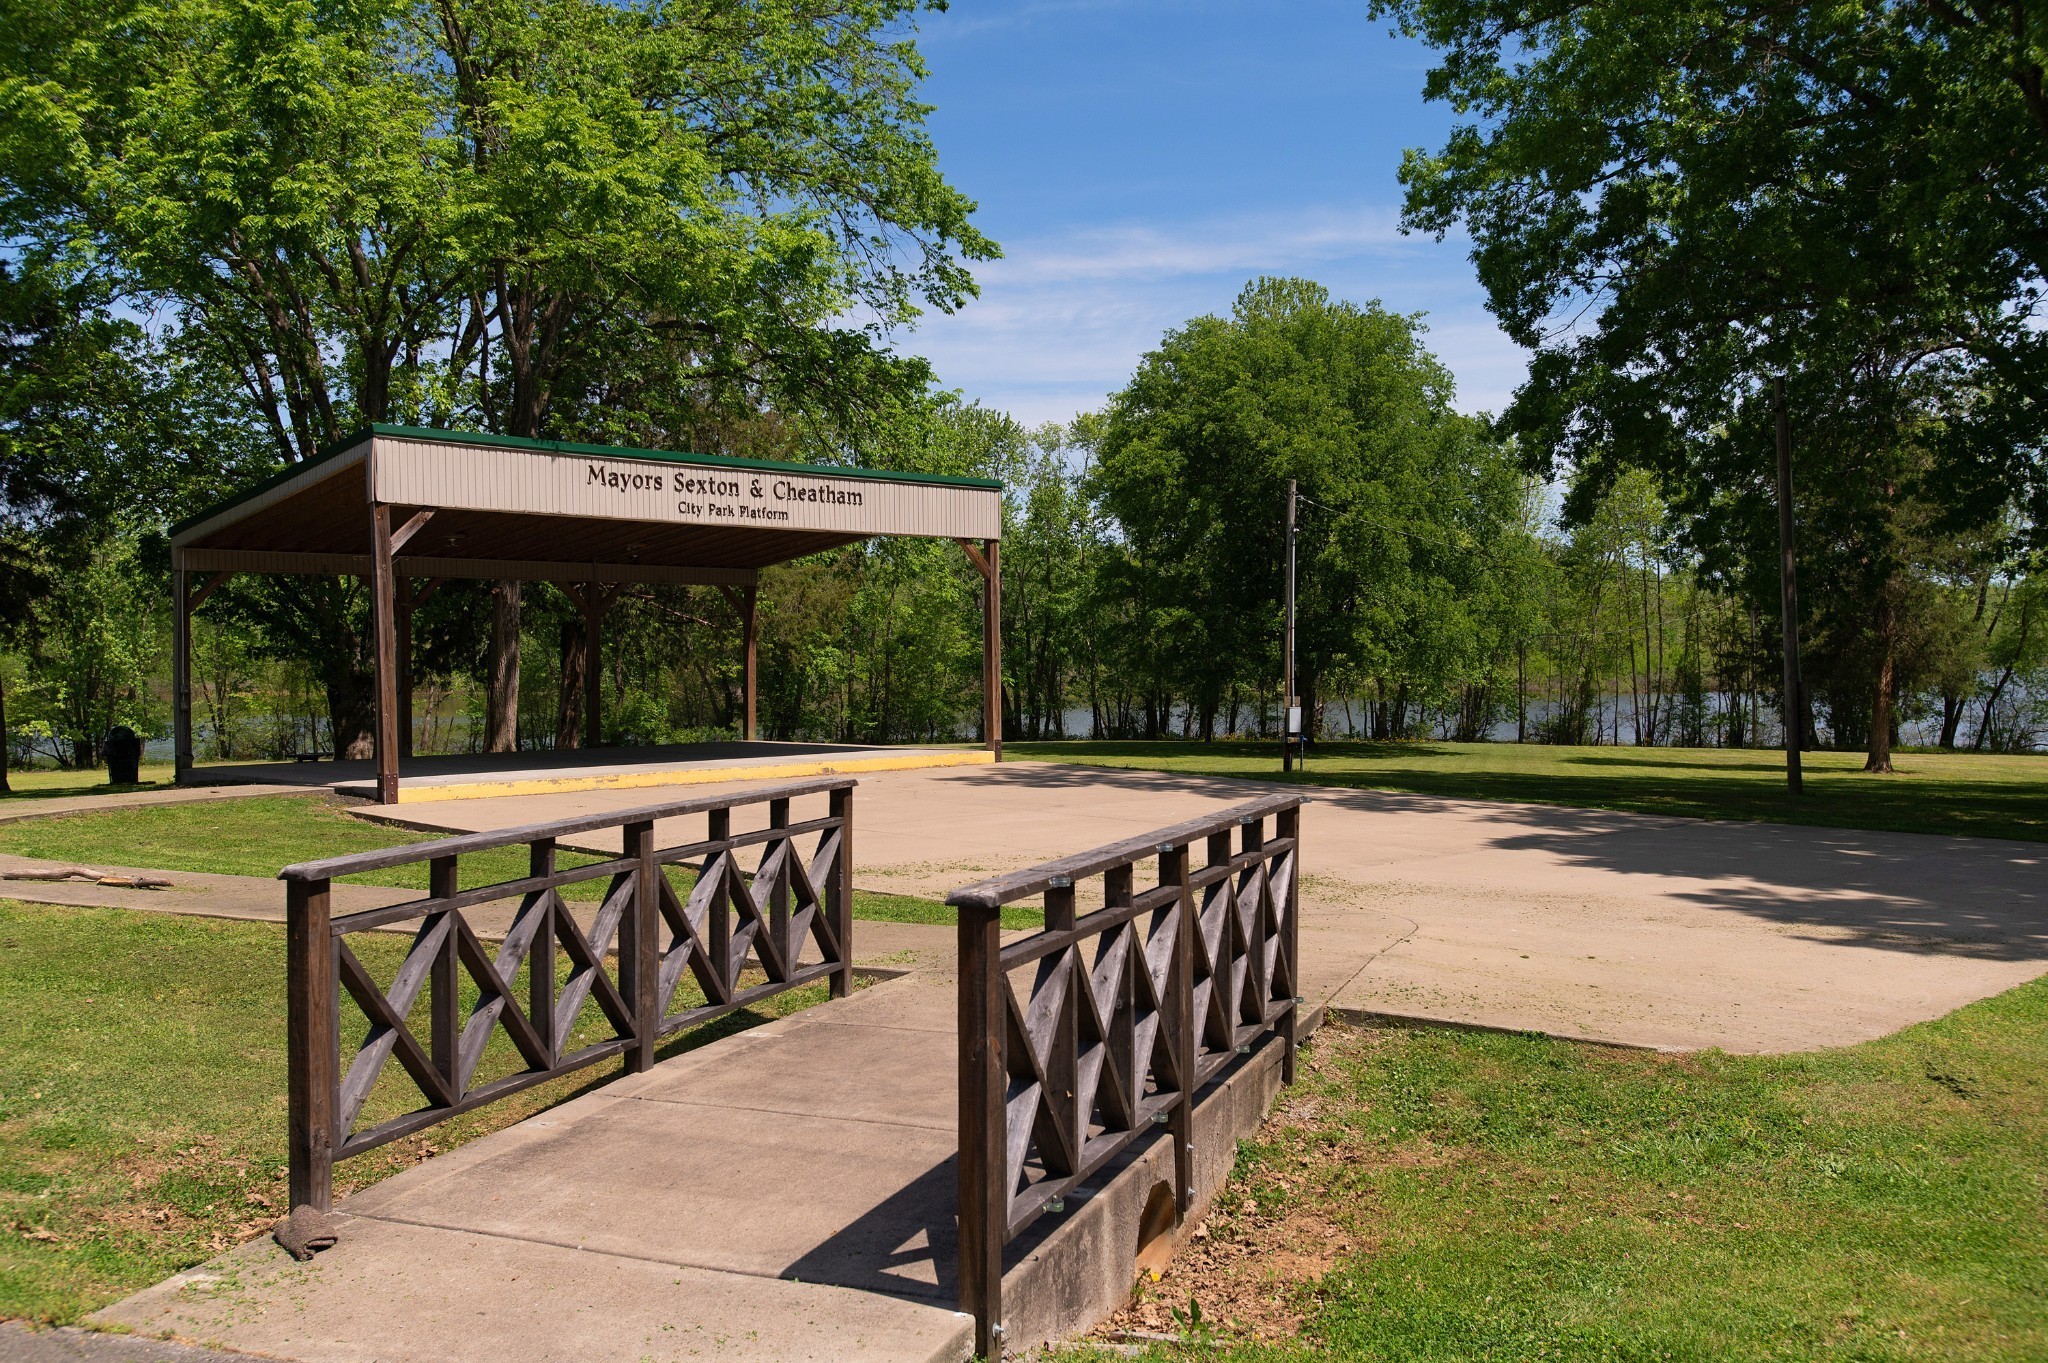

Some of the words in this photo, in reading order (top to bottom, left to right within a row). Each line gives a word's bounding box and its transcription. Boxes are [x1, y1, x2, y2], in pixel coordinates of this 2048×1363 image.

[586, 464, 663, 493] Mayors
[674, 472, 740, 498] Sexton
[749, 478, 764, 498] &
[772, 480, 863, 506] Cheatham
[677, 500, 703, 518] City
[708, 502, 735, 517] Park
[739, 504, 789, 521] Platform
